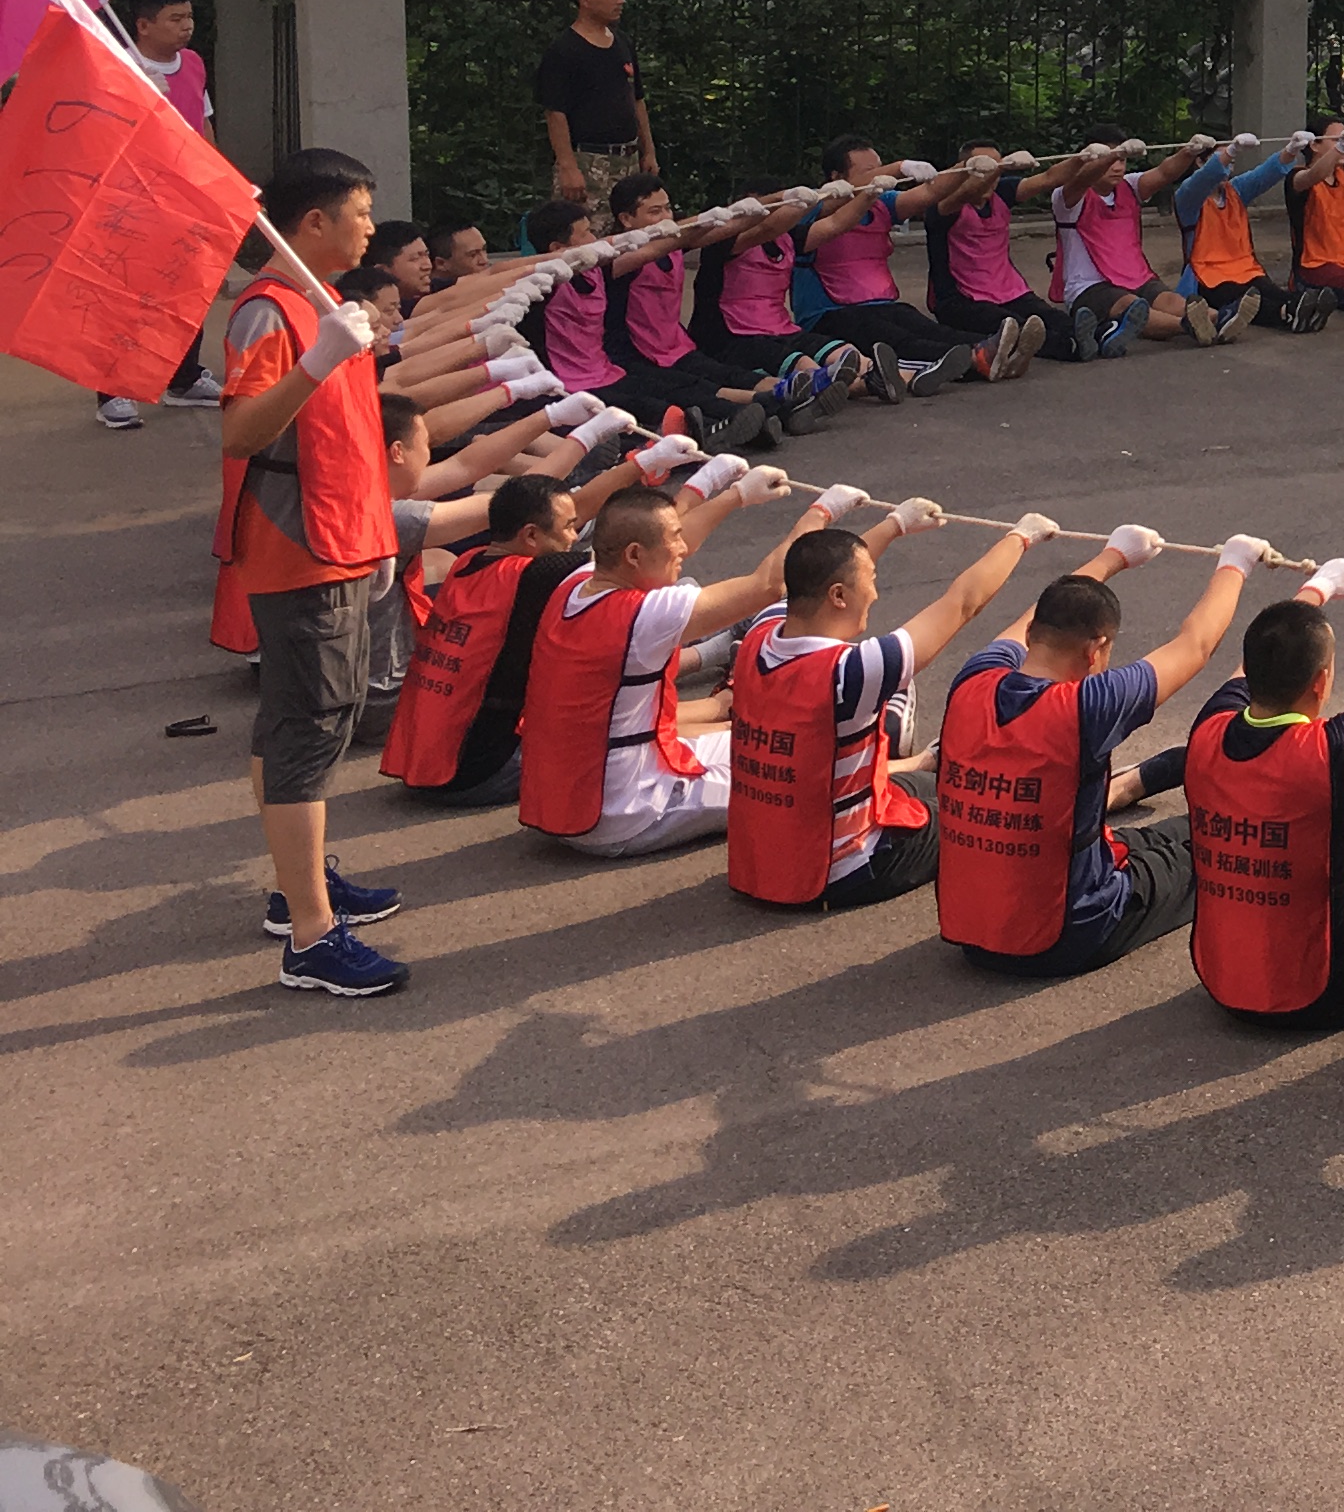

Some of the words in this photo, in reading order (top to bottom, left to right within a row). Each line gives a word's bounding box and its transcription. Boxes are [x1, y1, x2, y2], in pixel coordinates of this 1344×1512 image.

[735, 718, 796, 757] 剑中国
[945, 760, 1042, 803] 亮剑中国
[967, 804, 1044, 832] 拓展训练
[942, 826, 1041, 857] 5069130959
[1216, 851, 1292, 880] 拓展训练
